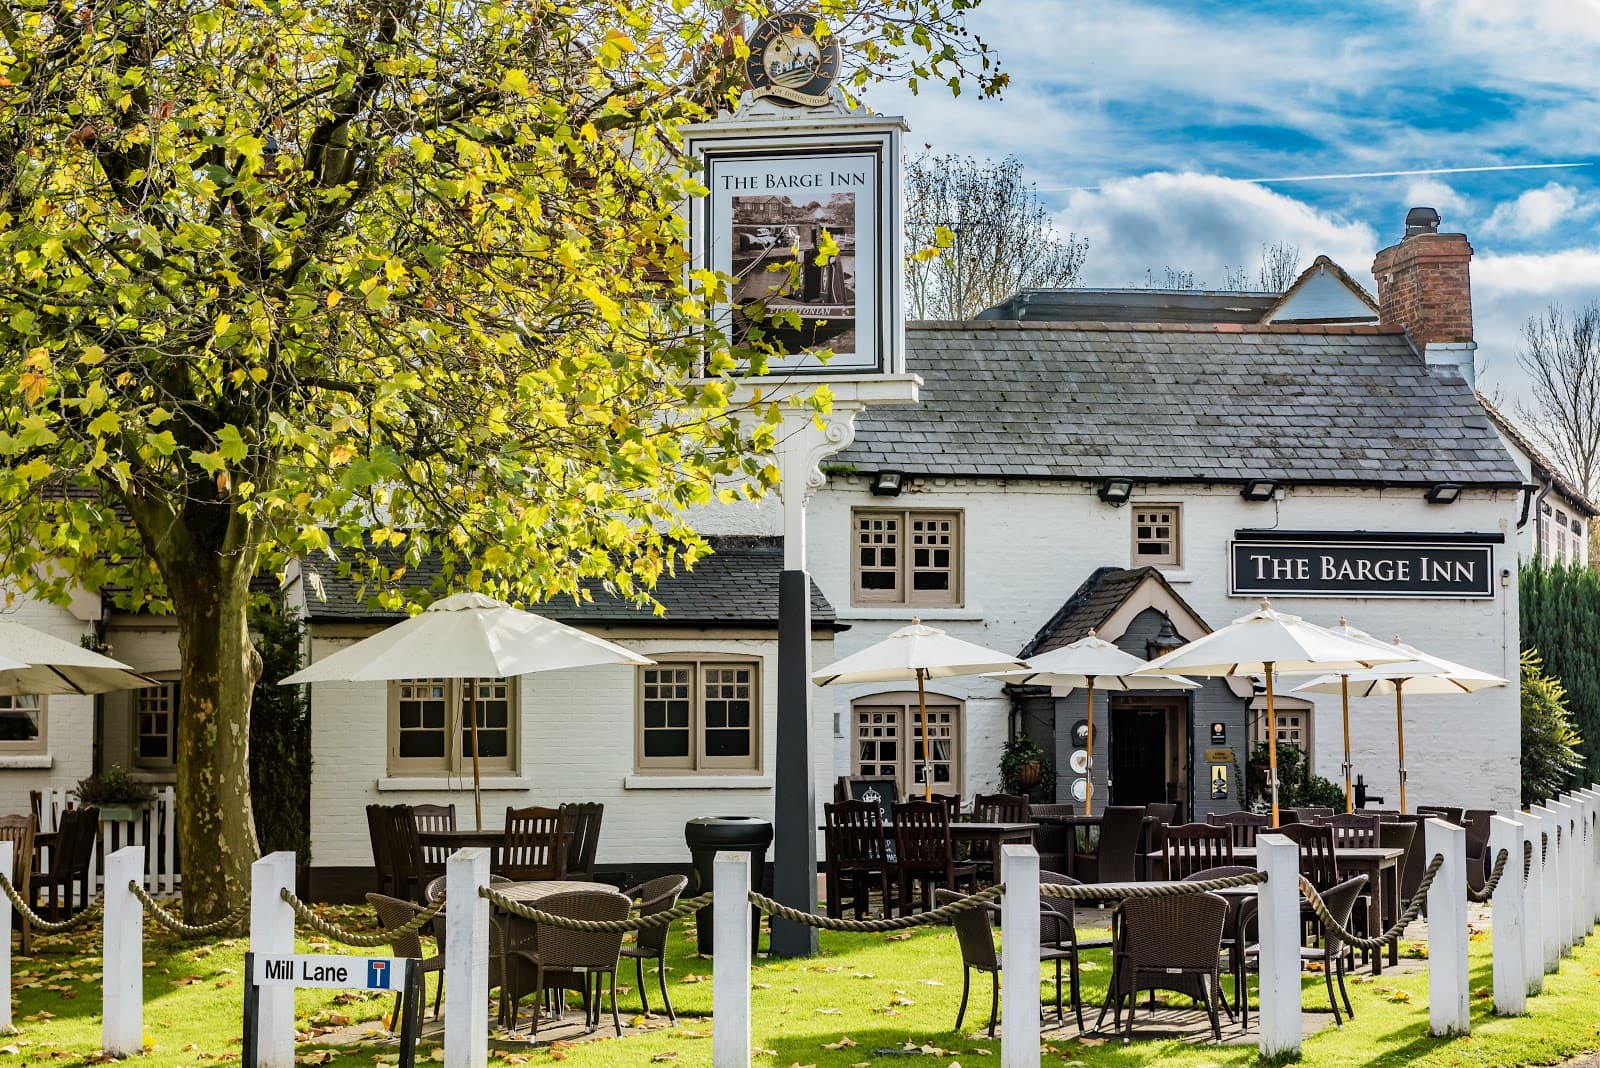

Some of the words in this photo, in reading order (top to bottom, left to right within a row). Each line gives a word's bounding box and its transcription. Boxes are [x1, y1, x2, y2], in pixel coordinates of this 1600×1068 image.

[721, 175, 758, 190] THE
[766, 174, 823, 189] BARGE
[830, 172, 865, 186] INN
[1250, 555, 1310, 580] THE
[1320, 556, 1410, 581] BARGE
[1420, 557, 1475, 582] INN
[265, 959, 294, 980] Mill
[303, 961, 348, 982] Lane
